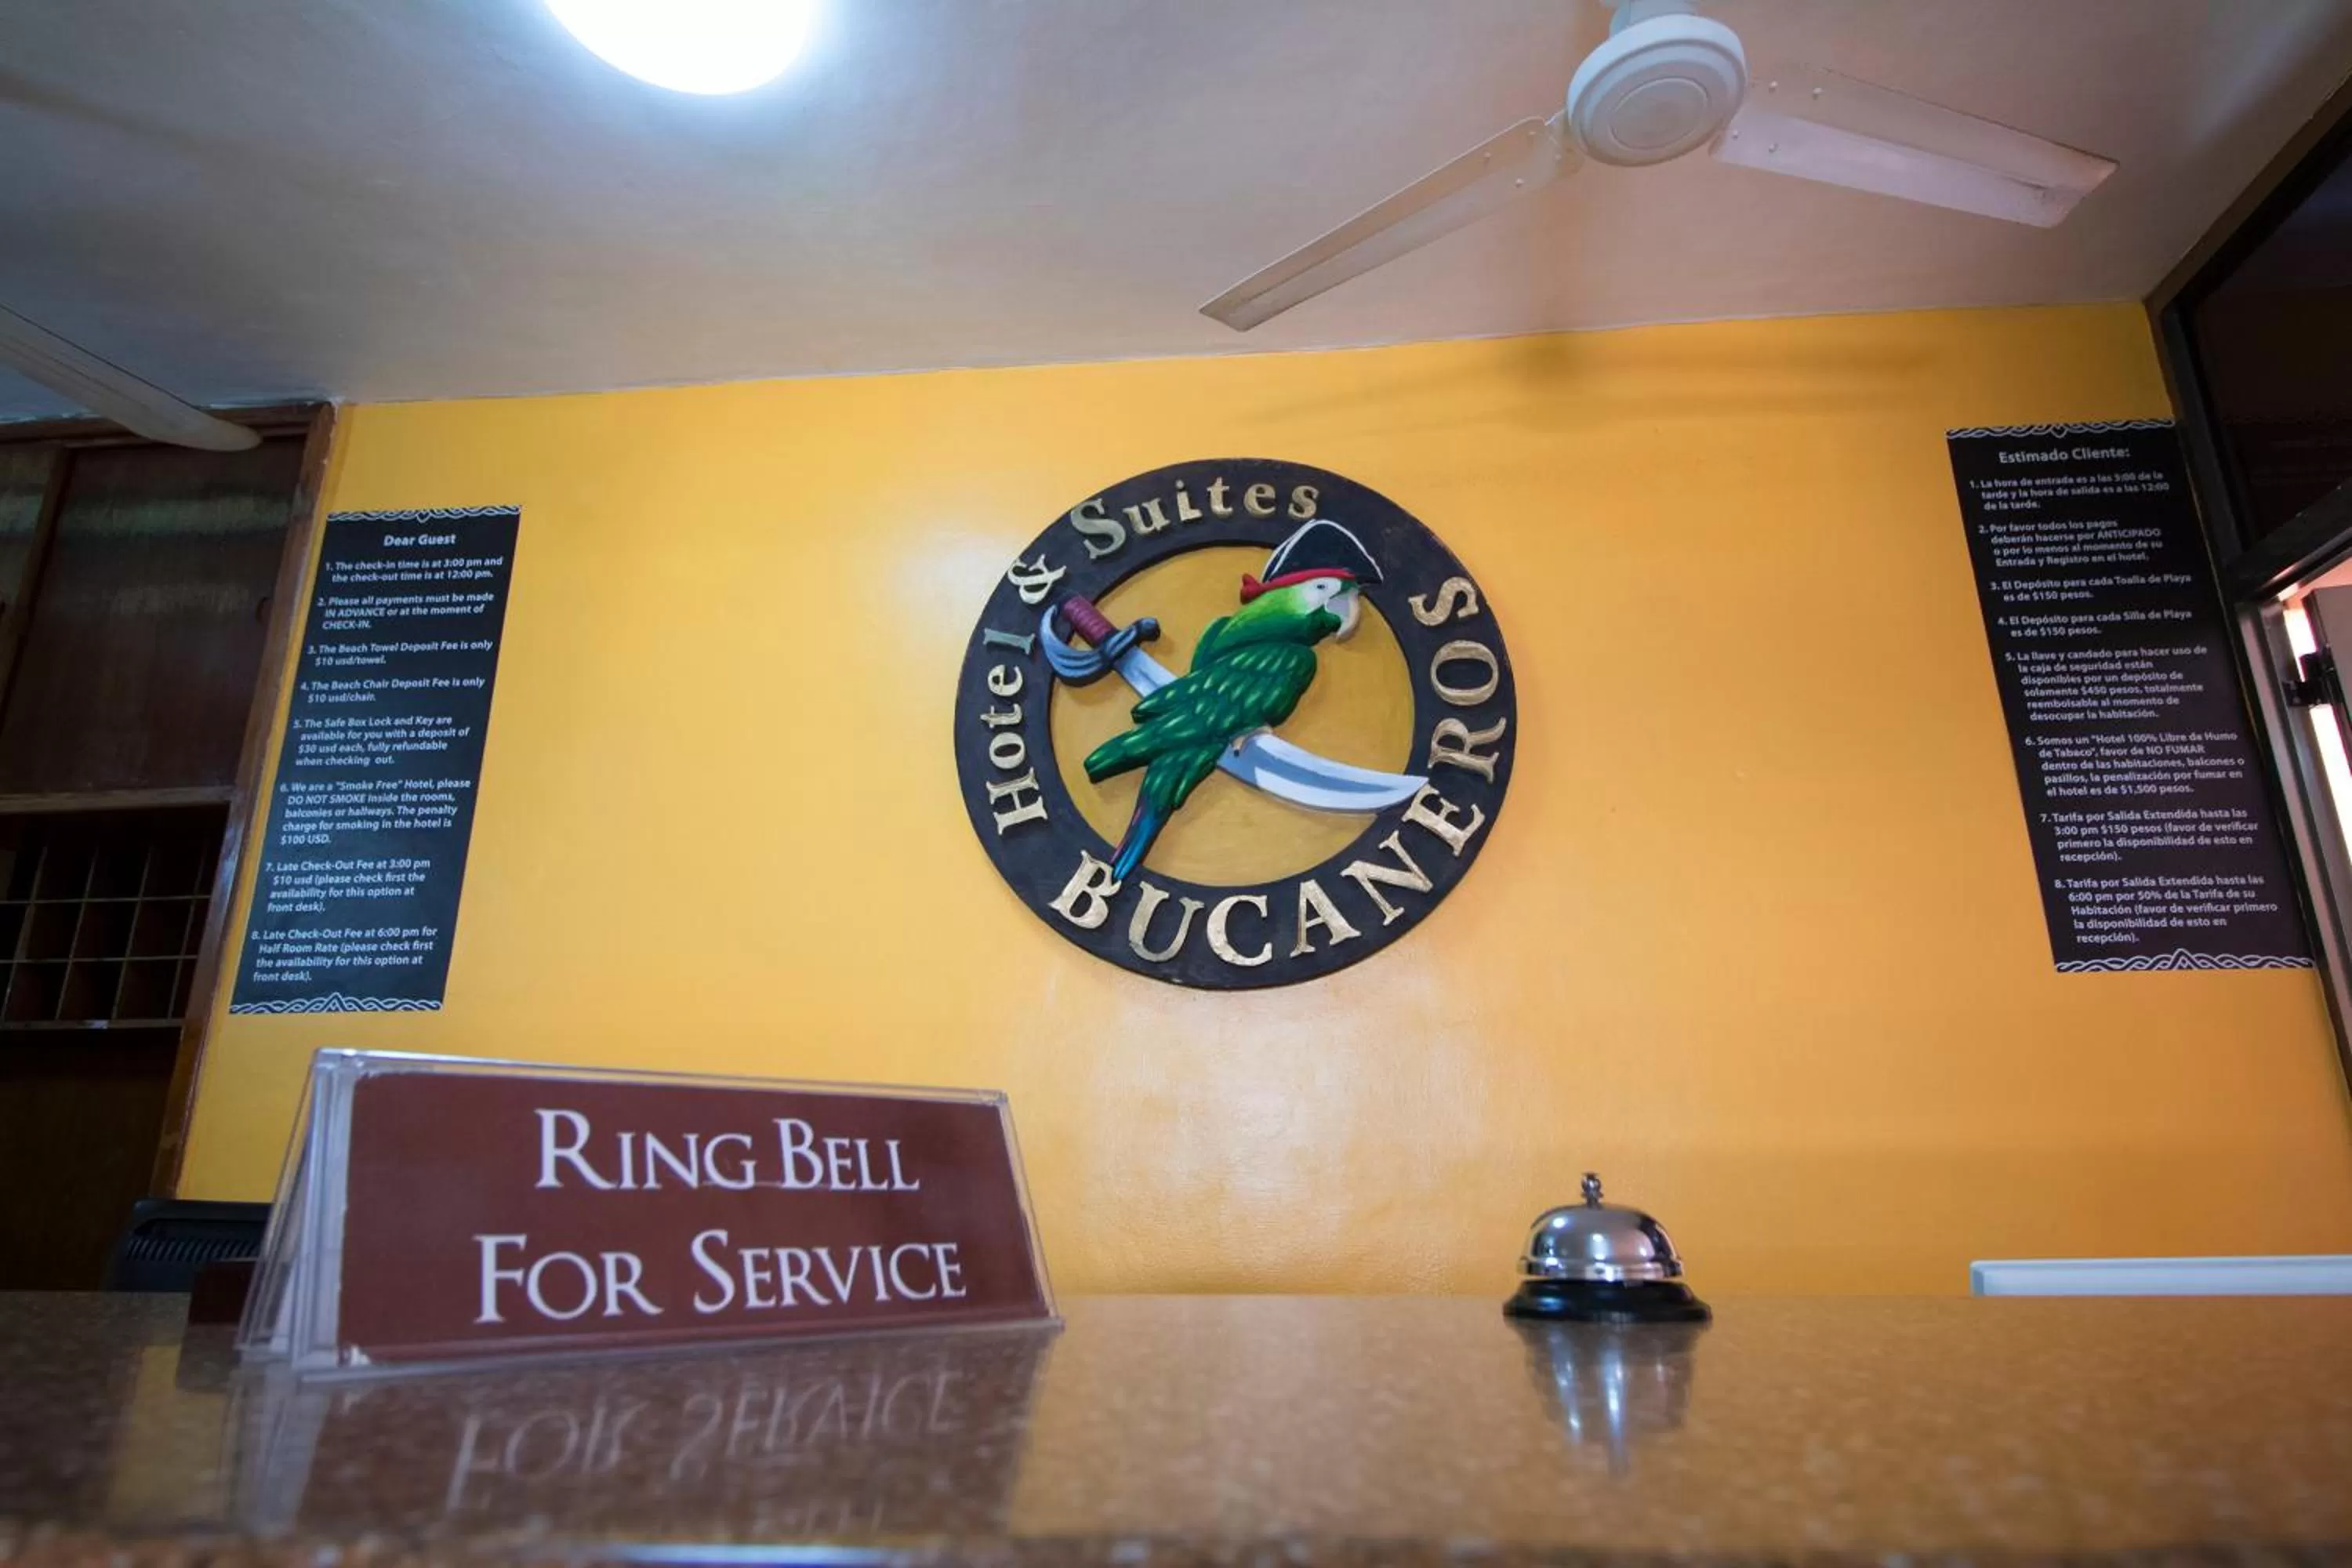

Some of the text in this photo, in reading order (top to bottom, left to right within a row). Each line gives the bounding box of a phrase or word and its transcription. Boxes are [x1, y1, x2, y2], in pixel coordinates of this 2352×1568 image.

[1999, 448, 2129, 463] Estimado Cliente:
[384, 535, 456, 546] Dear Guest
[336, 562, 353, 571] The
[485, 557, 503, 566] and
[350, 572, 398, 582] check-out
[424, 571, 432, 579] is
[448, 569, 473, 579] 12:00
[371, 643, 398, 652] Towel
[400, 641, 439, 652] Deposit
[470, 640, 492, 651] only
[979, 476, 1319, 836] Hotel & Suites
[325, 719, 345, 728] Safe
[368, 717, 391, 726] Lock
[394, 717, 414, 726] and
[416, 717, 434, 726] Key
[301, 731, 345, 740] available
[363, 732, 383, 741] you
[385, 729, 406, 738] with
[418, 728, 456, 739] deposit
[458, 728, 470, 736] of
[319, 744, 337, 753] usd
[368, 742, 390, 753] fully
[392, 741, 447, 750] refundable
[325, 756, 370, 767] checking
[1048, 576, 1508, 967] BUCANEROS
[289, 930, 342, 939] Check-Out
[344, 929, 362, 938] Fee
[378, 928, 400, 937] 6:00
[422, 927, 437, 936] for
[259, 944, 281, 953] Half
[282, 944, 312, 953] Room
[340, 943, 378, 953] (please
[380, 942, 409, 951] check
[412, 942, 433, 950] first
[257, 956, 422, 968] the availability for this option at
[254, 972, 279, 981] front
[535, 1109, 920, 1190] RING BELL
[475, 1229, 966, 1322] FOR SERVICE
